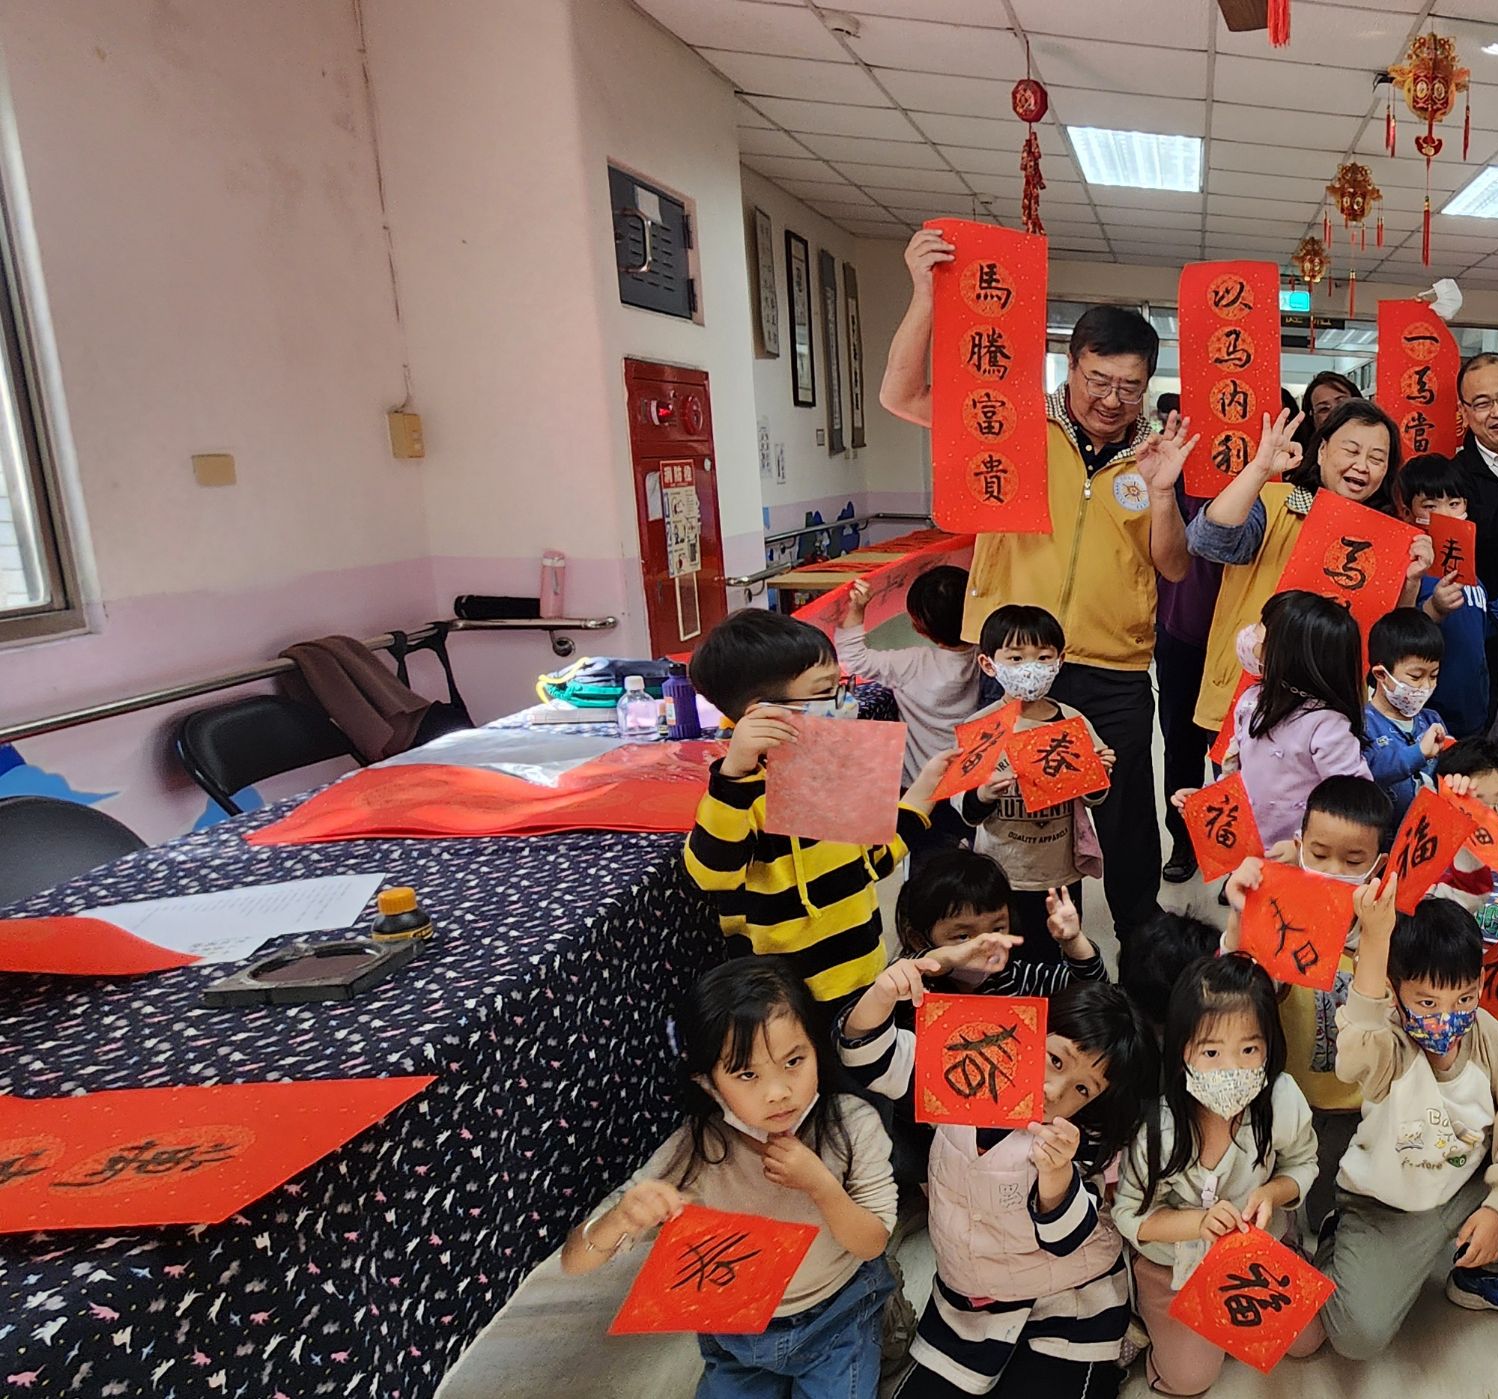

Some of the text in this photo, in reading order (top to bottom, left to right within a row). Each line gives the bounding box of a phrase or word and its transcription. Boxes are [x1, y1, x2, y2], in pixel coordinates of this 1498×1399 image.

[966, 263, 1012, 503] 馬騰富貴
[1031, 731, 1082, 777] 春
[1008, 830, 1037, 844] QUALITY
[1206, 795, 1240, 848] 福
[1396, 814, 1439, 879] 福
[944, 1023, 1021, 1104] 春
[671, 1231, 762, 1292] 春
[1218, 1262, 1292, 1327] 福
